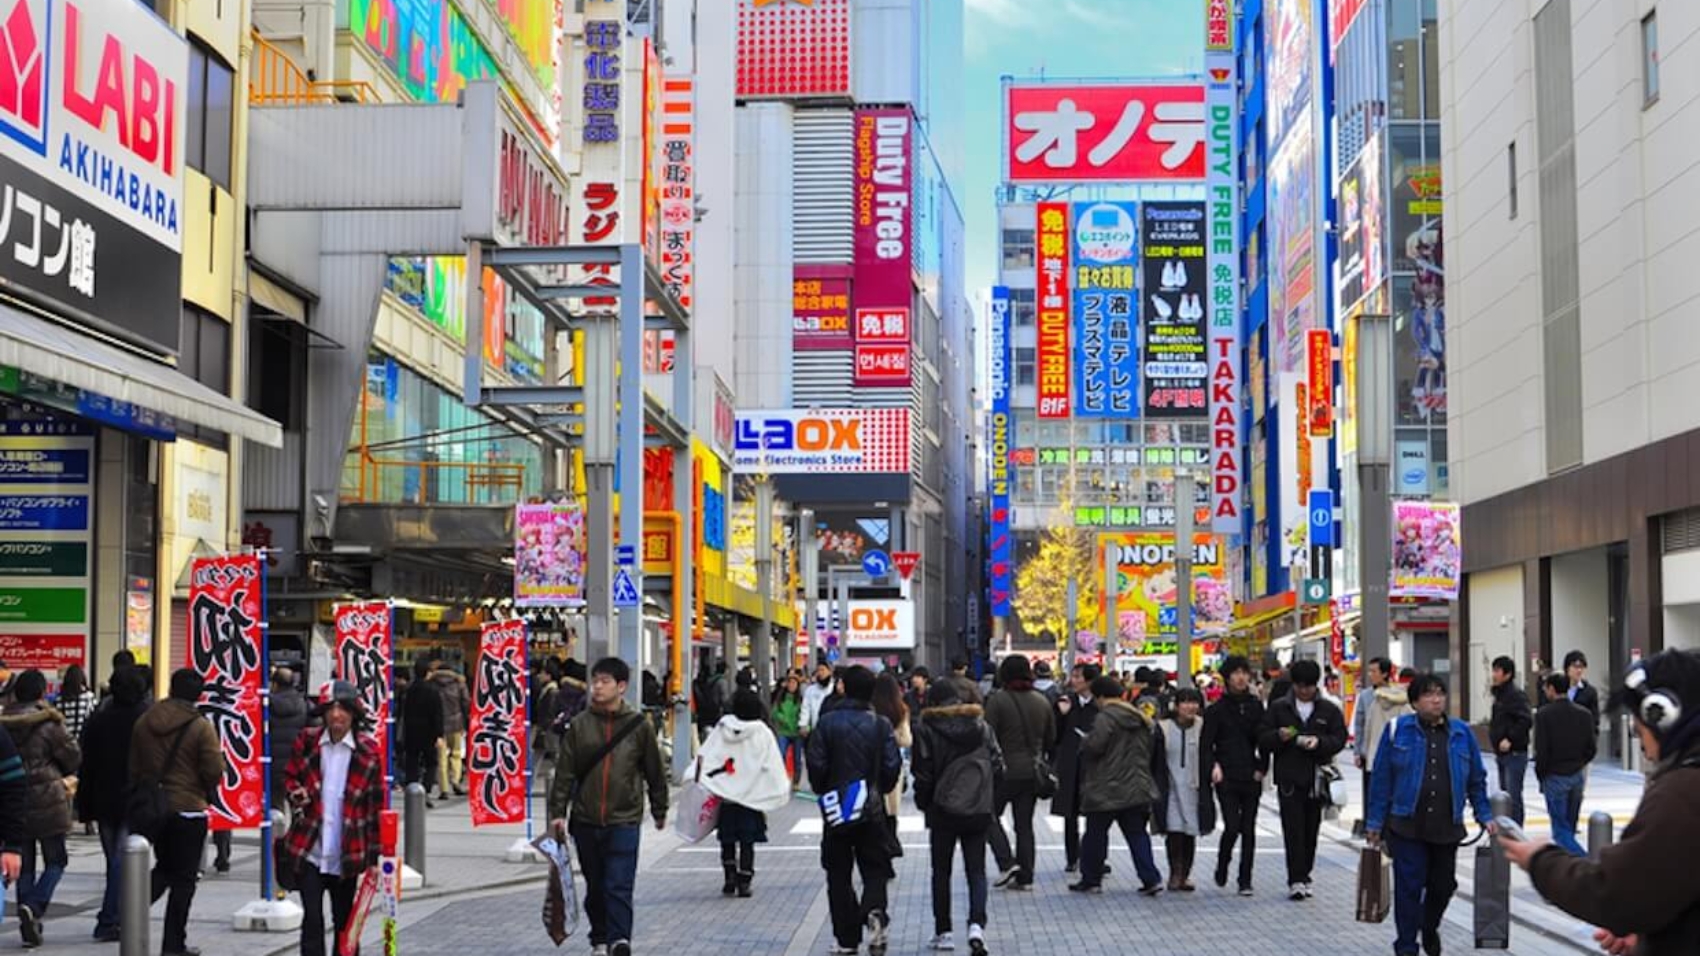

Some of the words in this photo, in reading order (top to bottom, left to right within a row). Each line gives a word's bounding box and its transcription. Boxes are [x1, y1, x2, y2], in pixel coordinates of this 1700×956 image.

[63, 2, 175, 177] LABI
[583, 21, 621, 142] 電化製品
[665, 140, 689, 199] 買取り
[858, 116, 874, 179] Flagship
[872, 116, 909, 187] Duty
[1211, 105, 1231, 177] DUTY
[59, 132, 179, 234] AKIHABARA
[859, 184, 874, 226] Store
[875, 192, 909, 259] Free
[1213, 185, 1233, 254] FREE
[861, 314, 905, 336] 免税
[1213, 264, 1233, 327] 免税店
[859, 354, 906, 370] 면세점
[992, 298, 1009, 400] Panasonic
[1041, 312, 1065, 354] DUTY
[1110, 295, 1129, 410] 液晶テレビ
[1040, 397, 1068, 415] B1F
[1041, 355, 1067, 394] FREE
[735, 457, 760, 465] ome
[764, 454, 827, 466] Electronics
[830, 454, 863, 465] Store
[1213, 338, 1238, 518] TAKARADA
